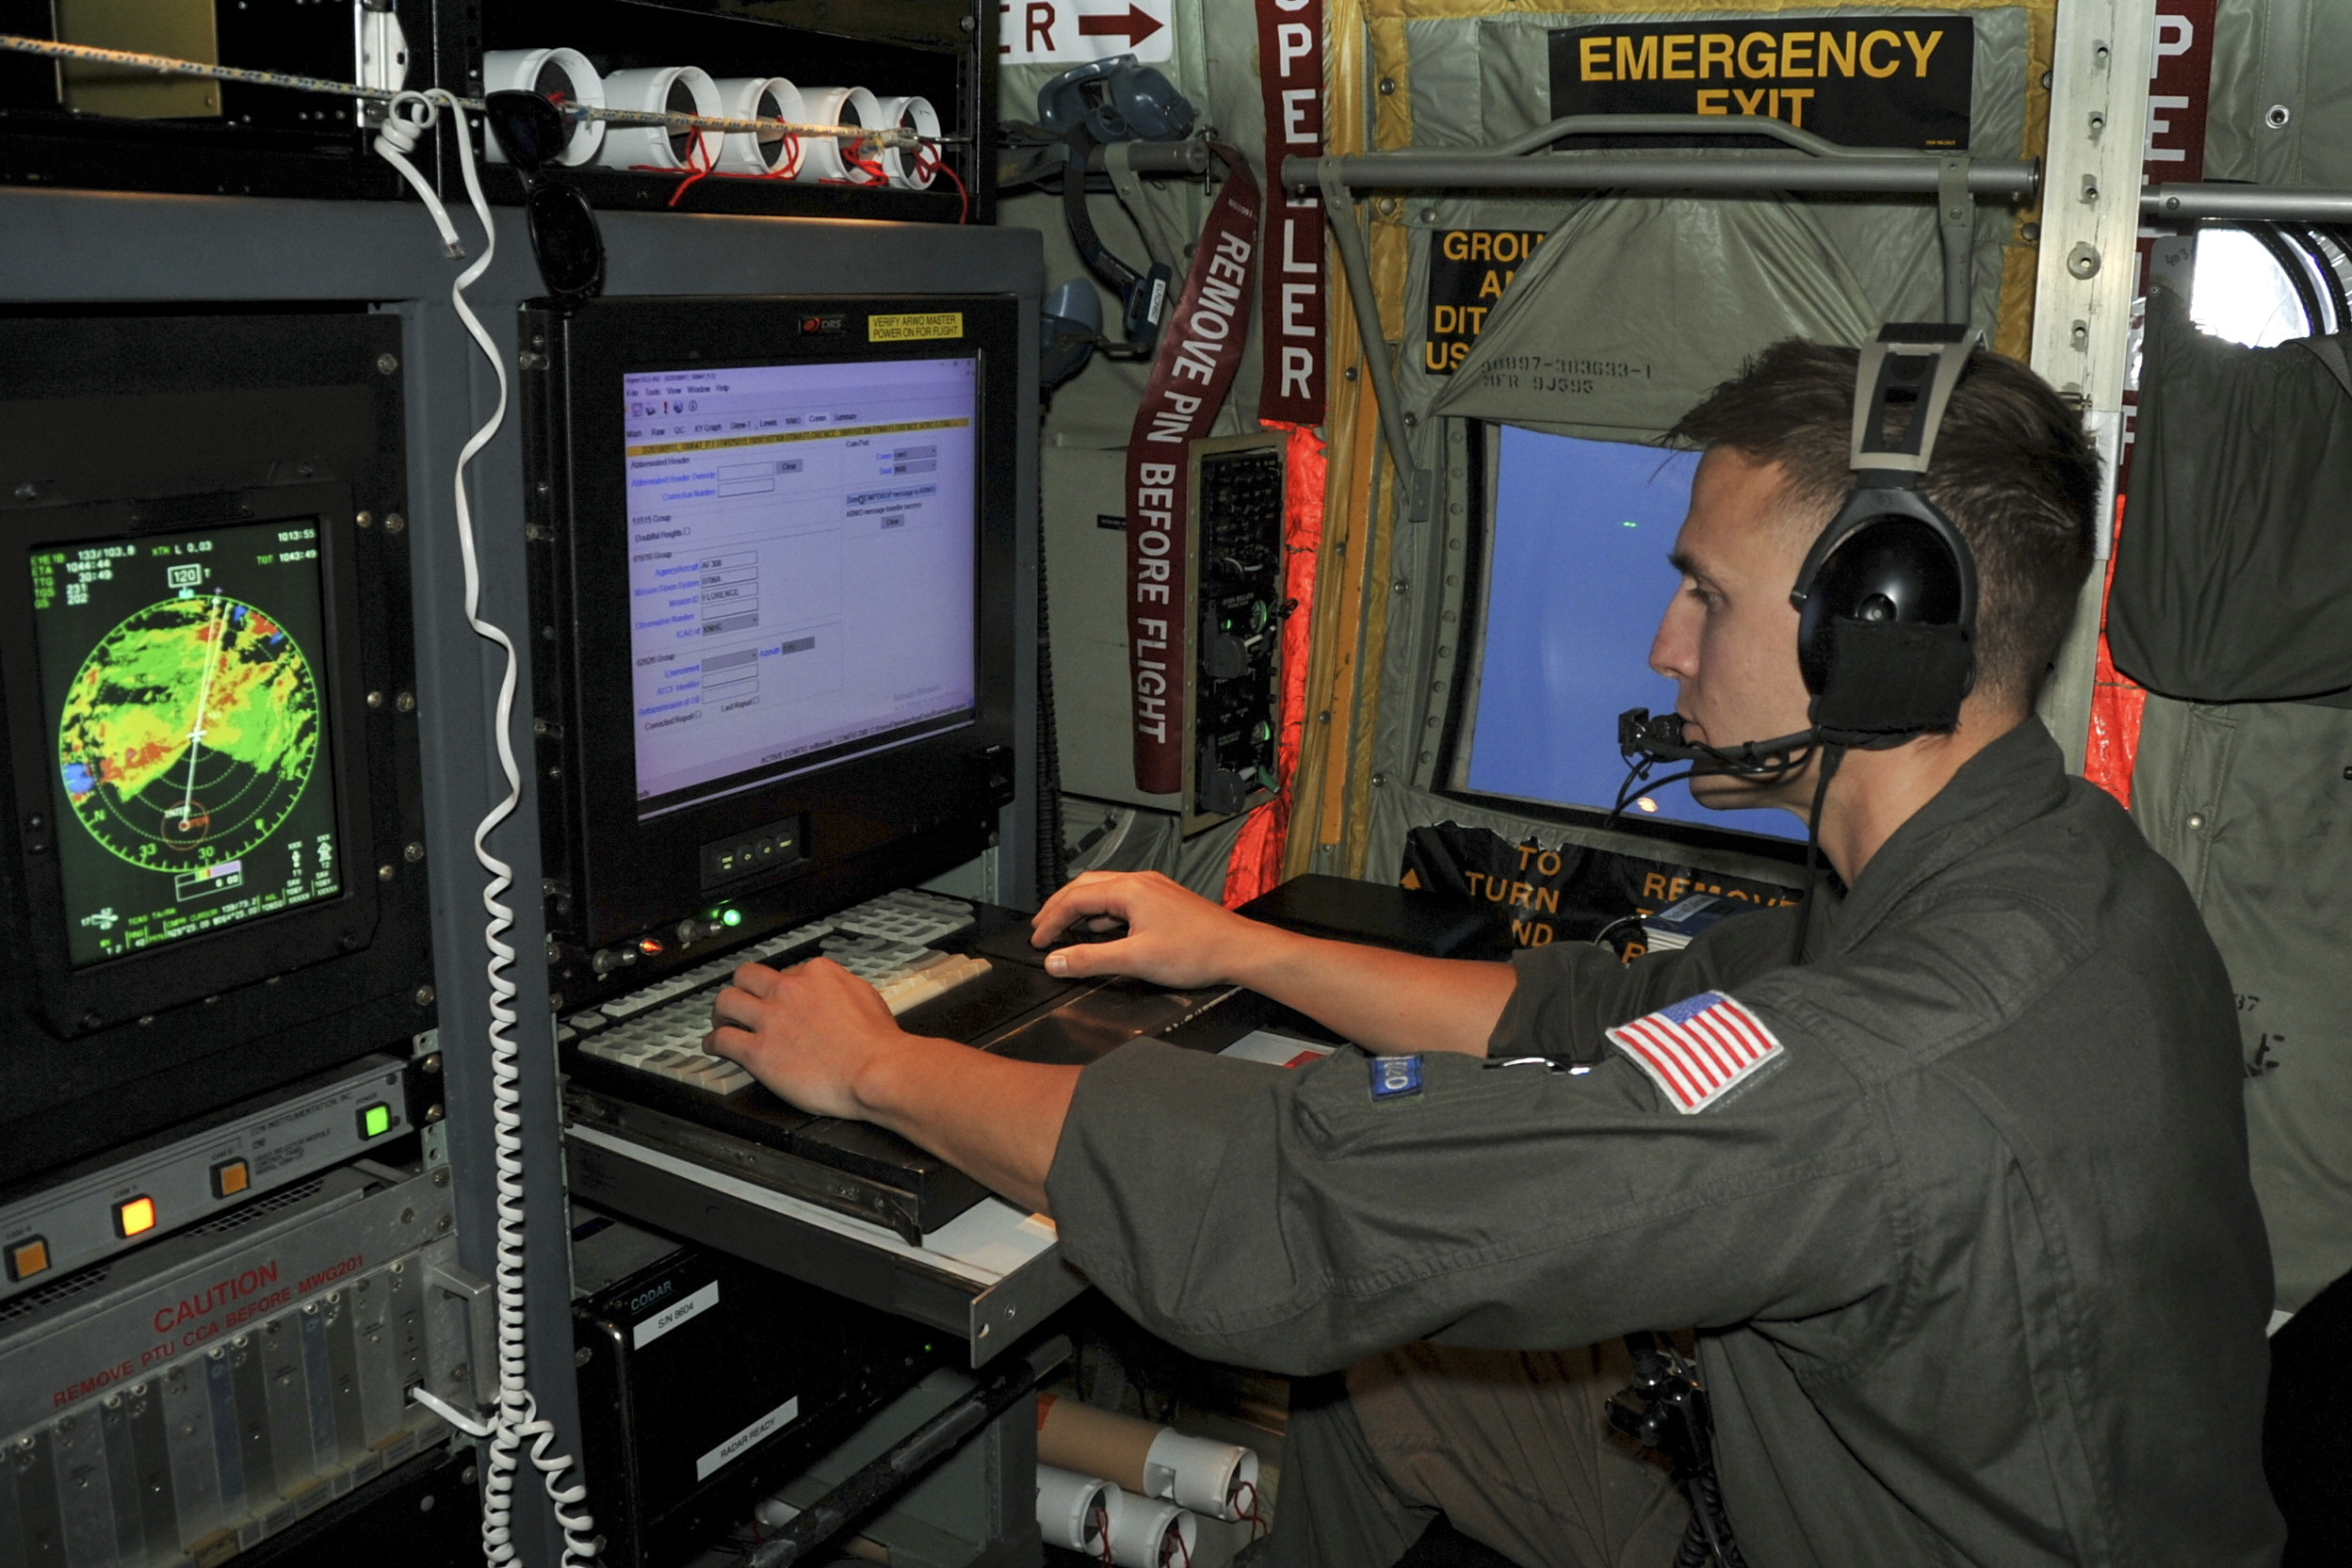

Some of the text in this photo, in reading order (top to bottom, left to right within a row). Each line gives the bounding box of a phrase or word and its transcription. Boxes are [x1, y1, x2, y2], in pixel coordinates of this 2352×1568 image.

[1579, 29, 1944, 81] EMERGENCY
[1273, 0, 1319, 399] PELER
[821, 319, 842, 329] DRS
[873, 315, 956, 327] VERIFY ARWO MASTER
[1435, 305, 1488, 334] DIT
[873, 326, 958, 340] POWER ON FOR FLIGHT
[687, 384, 710, 394] Window
[716, 384, 729, 394] Help
[1137, 230, 1251, 744] REMOVE PIN BEFORE FLIGHT
[277, 528, 316, 542] 1013:55
[174, 544, 183, 555] L
[187, 540, 214, 554] 0.03
[256, 549, 316, 565] TOT 1043:49
[66, 558, 112, 573] 1044:44
[78, 569, 113, 583] 30:49
[172, 569, 196, 583] 120
[66, 583, 88, 594] 231
[702, 589, 739, 602] FLORENCE
[67, 593, 89, 606] 202
[94, 810, 106, 821] N
[198, 845, 216, 859] 30
[1517, 844, 1563, 877] TO
[1465, 870, 1561, 914] TURN
[153, 1260, 279, 1334] CAUTION
[630, 1280, 673, 1312] CODAR
[53, 1253, 365, 1409] REMOVE PTU CCA BEFORE MWG201
[720, 1416, 776, 1460] RADAR READY
